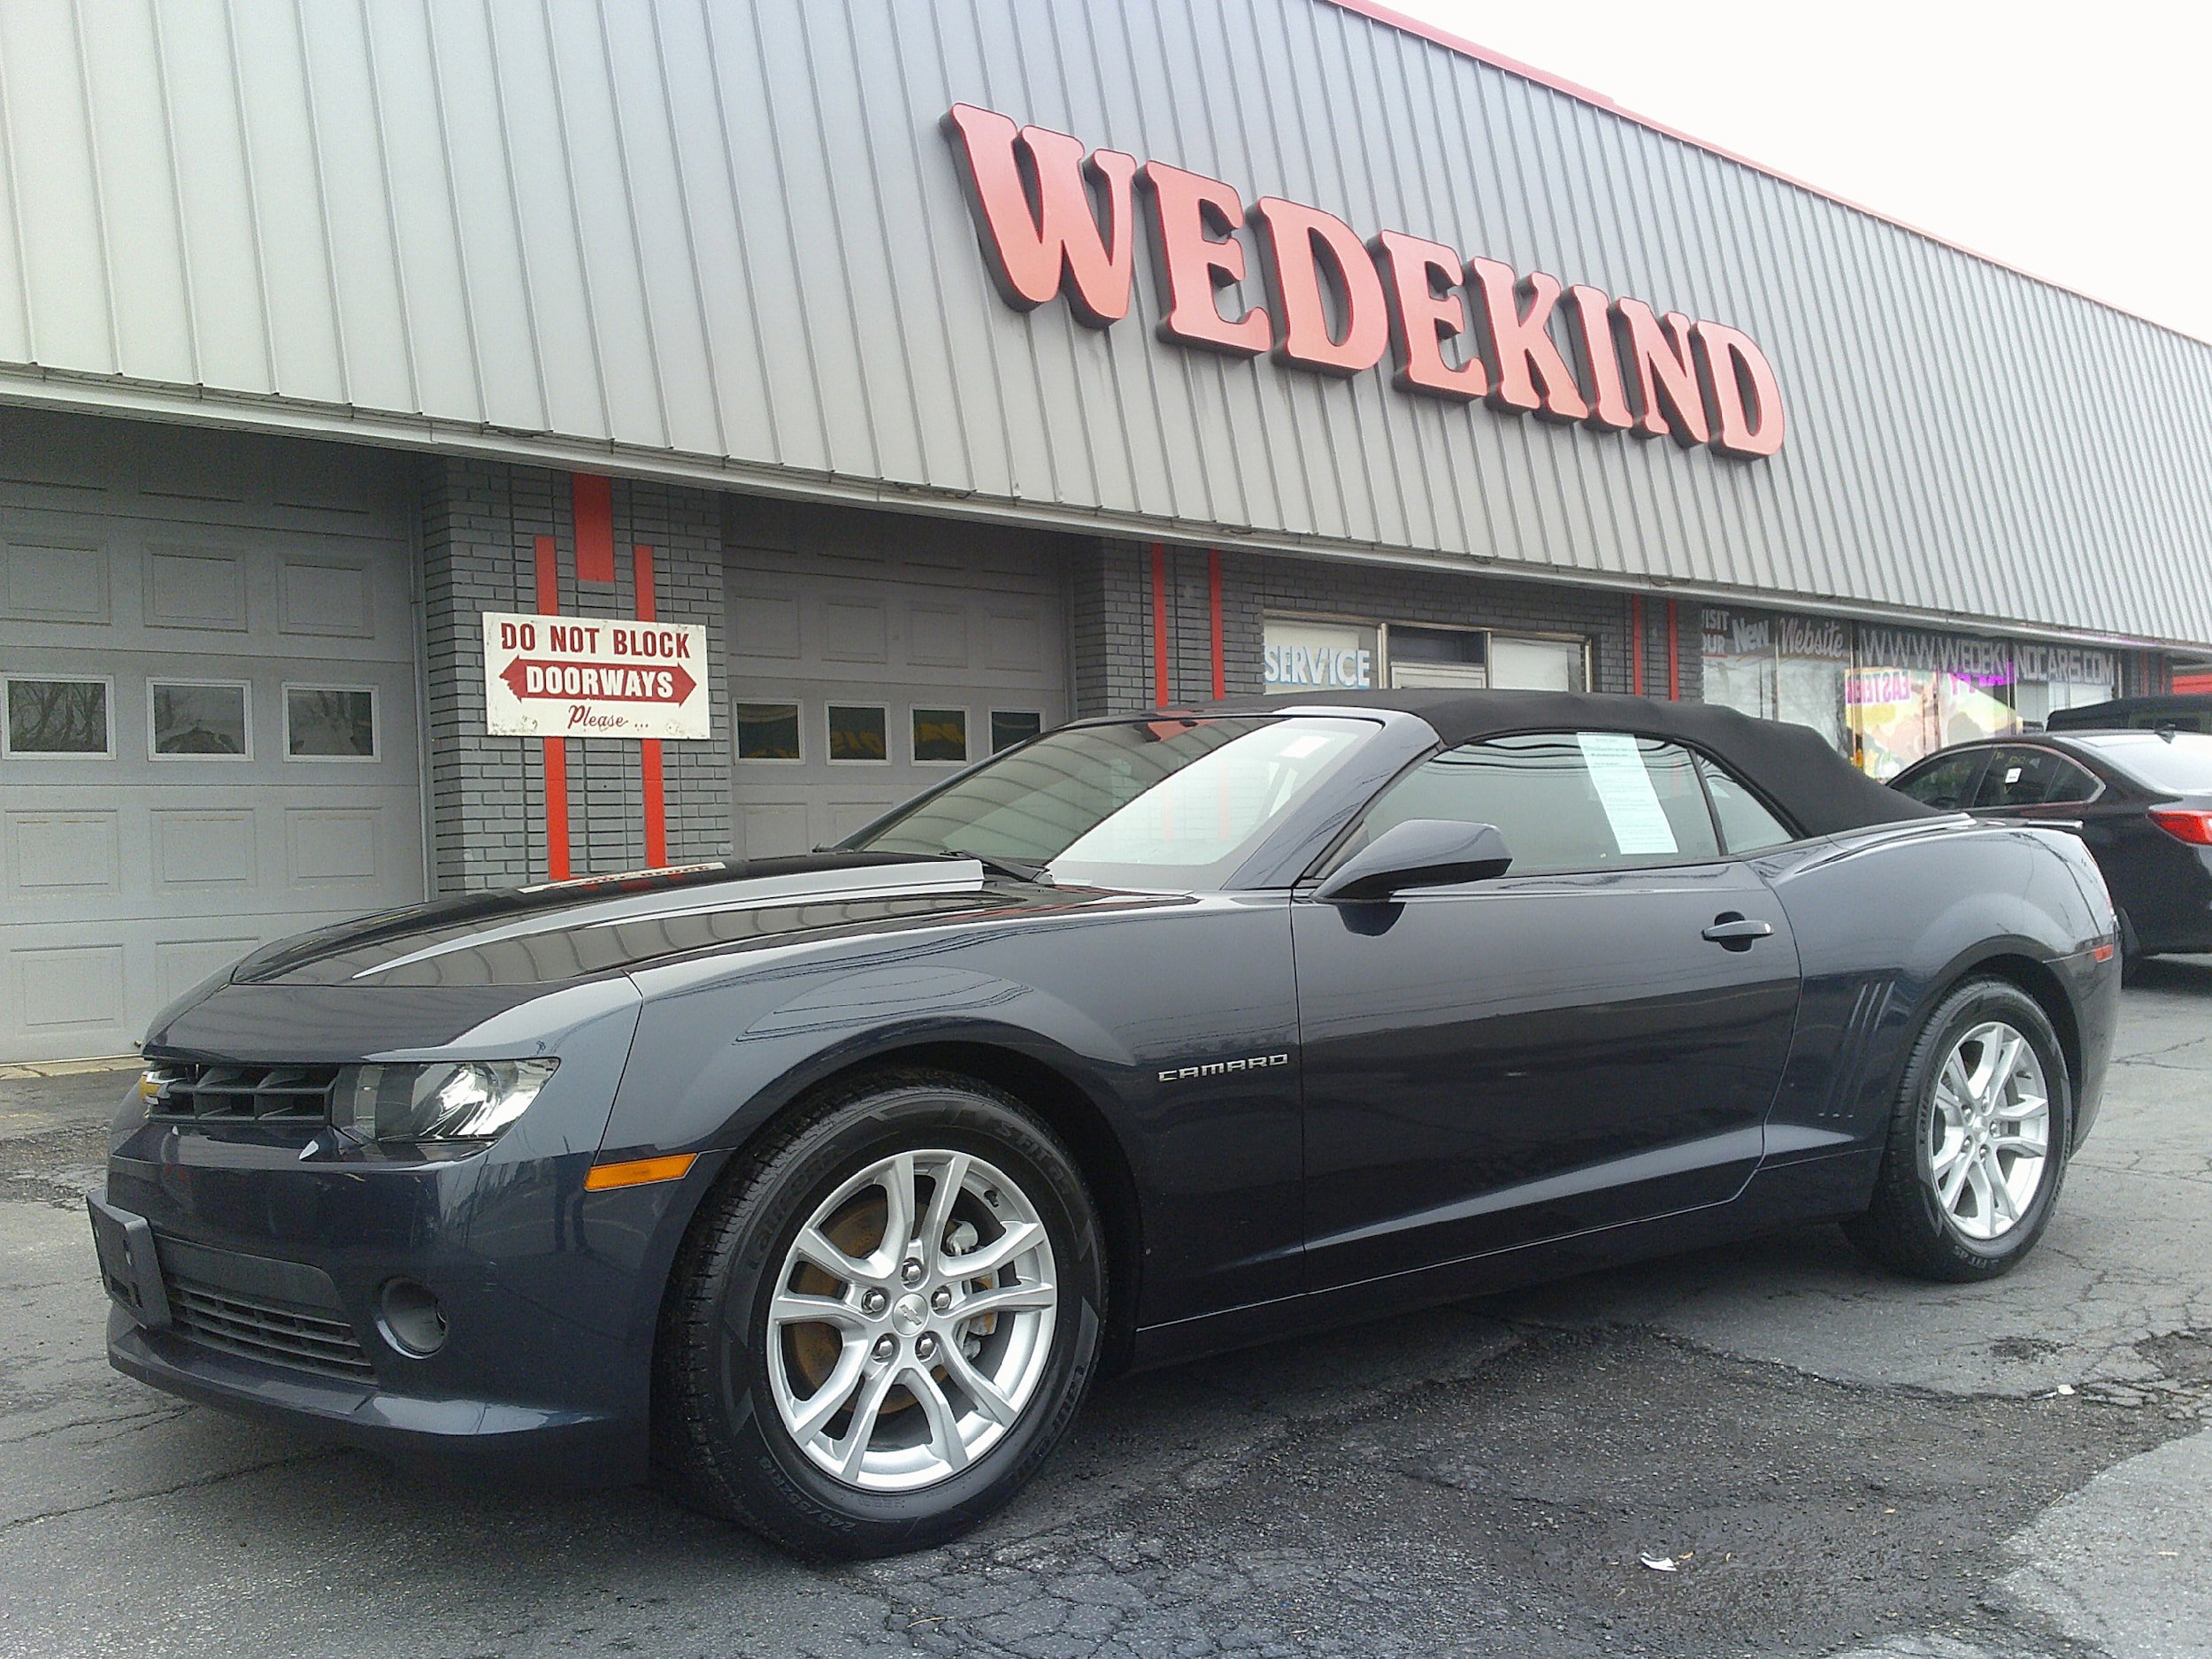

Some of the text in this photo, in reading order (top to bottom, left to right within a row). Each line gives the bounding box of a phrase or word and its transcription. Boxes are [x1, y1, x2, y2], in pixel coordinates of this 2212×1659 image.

[942, 100, 1786, 461] WEDEKIND
[501, 622, 691, 659] DO NOT BLOCK
[526, 665, 674, 699] DOORWAYS
[1263, 645, 1371, 689] SERVICE
[567, 704, 629, 730] Please
[1158, 1053, 1288, 1082] CAMARO
